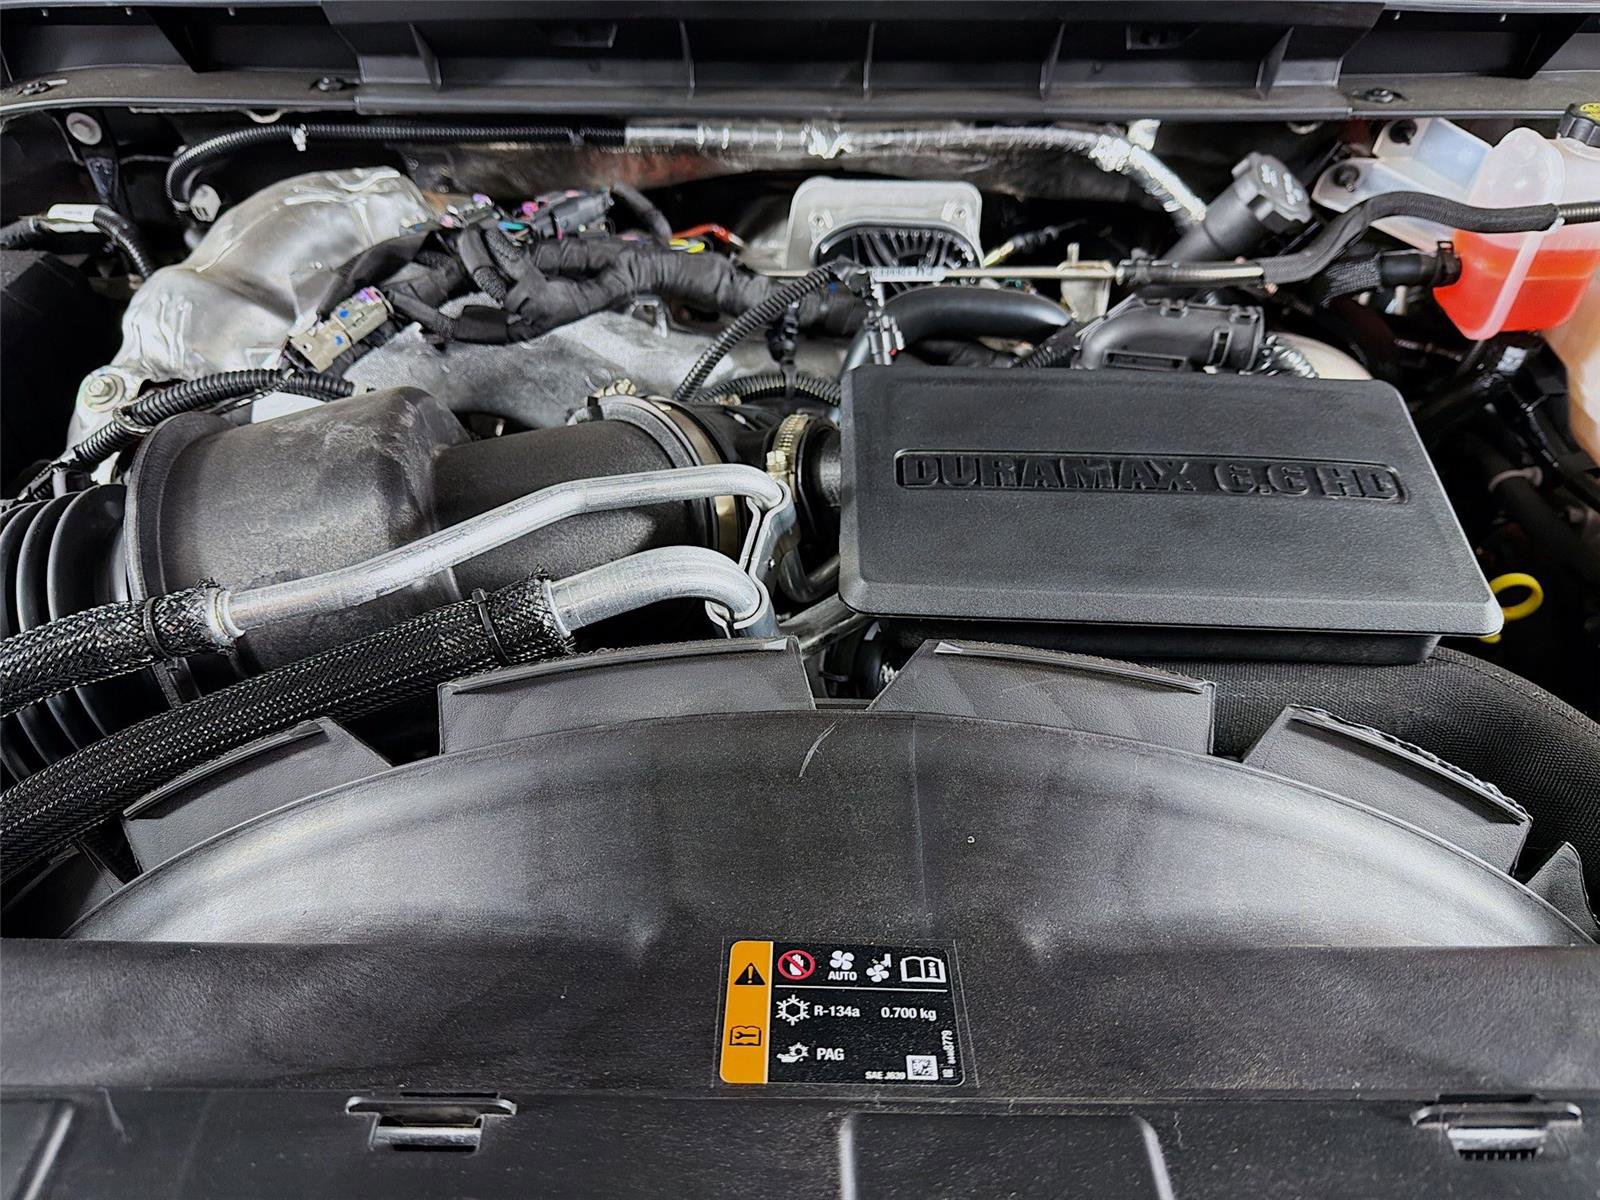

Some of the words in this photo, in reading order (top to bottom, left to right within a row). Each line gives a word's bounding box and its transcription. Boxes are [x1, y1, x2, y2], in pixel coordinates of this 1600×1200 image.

[902, 456, 1196, 492] DURAMAX
[1215, 462, 1309, 496] 6.6
[1314, 466, 1399, 501] HD
[828, 971, 858, 981] AUTO
[814, 1006, 861, 1018] R-134a
[881, 1006, 917, 1019] 0.700
[920, 1006, 937, 1022] kg
[816, 1048, 845, 1061] PAG
[865, 1071, 884, 1080] SAE
